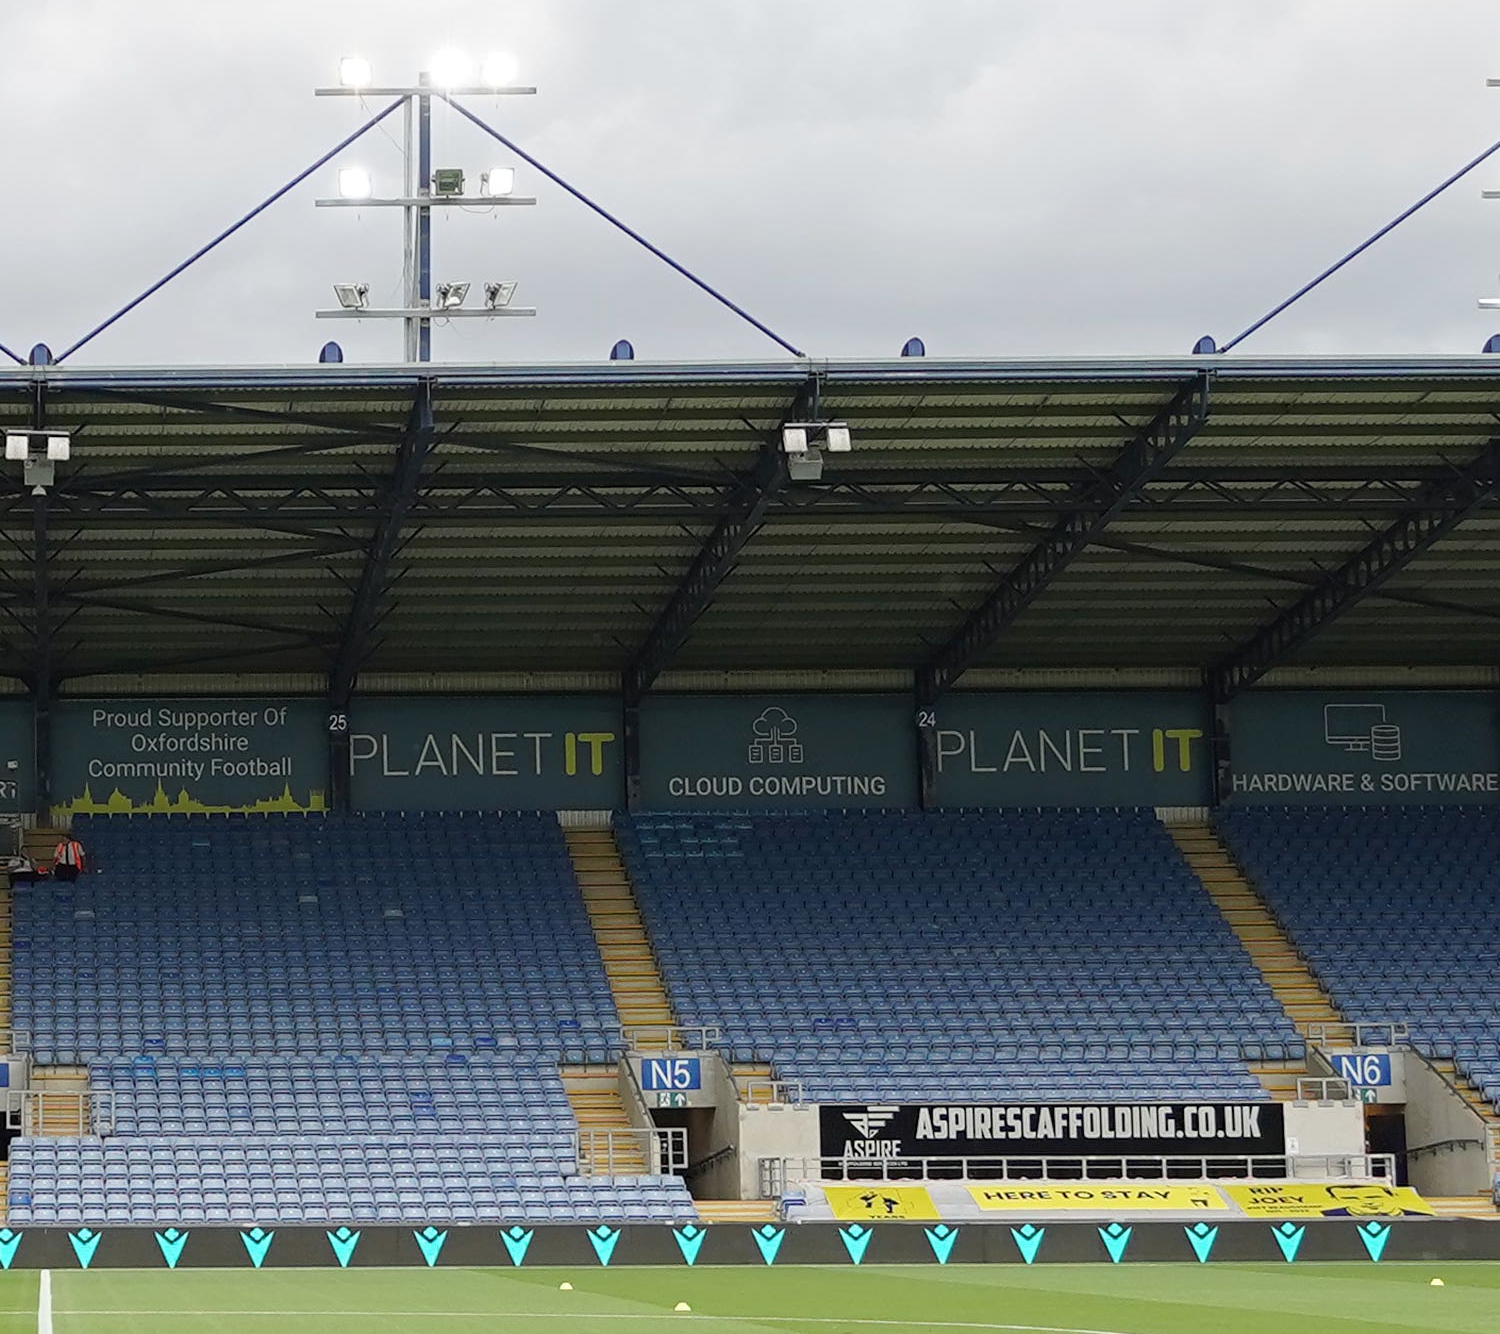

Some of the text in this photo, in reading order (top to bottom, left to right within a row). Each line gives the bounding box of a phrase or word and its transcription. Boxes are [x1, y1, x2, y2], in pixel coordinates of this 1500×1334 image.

[93, 706, 287, 733] Proud Supporter Of
[329, 714, 347, 731] 25
[918, 711, 936, 727] 24
[131, 732, 249, 752] Oxfordshire
[936, 728, 1203, 772] PLANET IT
[349, 732, 615, 776] PLANET IT
[88, 757, 292, 782] Community Football
[669, 776, 885, 796] CLOUD COMPUTING
[1232, 773, 1499, 792] HARDWARE & SOFTWARE
[651, 1060, 692, 1089] N5
[1341, 1055, 1381, 1085] N6
[915, 1106, 1262, 1139] ASPIRESCAFFOLDING.CO.UK
[843, 1139, 902, 1157] ASPIRE
[983, 1190, 1171, 1200] HERE TO STAY
[1248, 1186, 1283, 1195] RIP
[1248, 1196, 1304, 1205] JOEY
